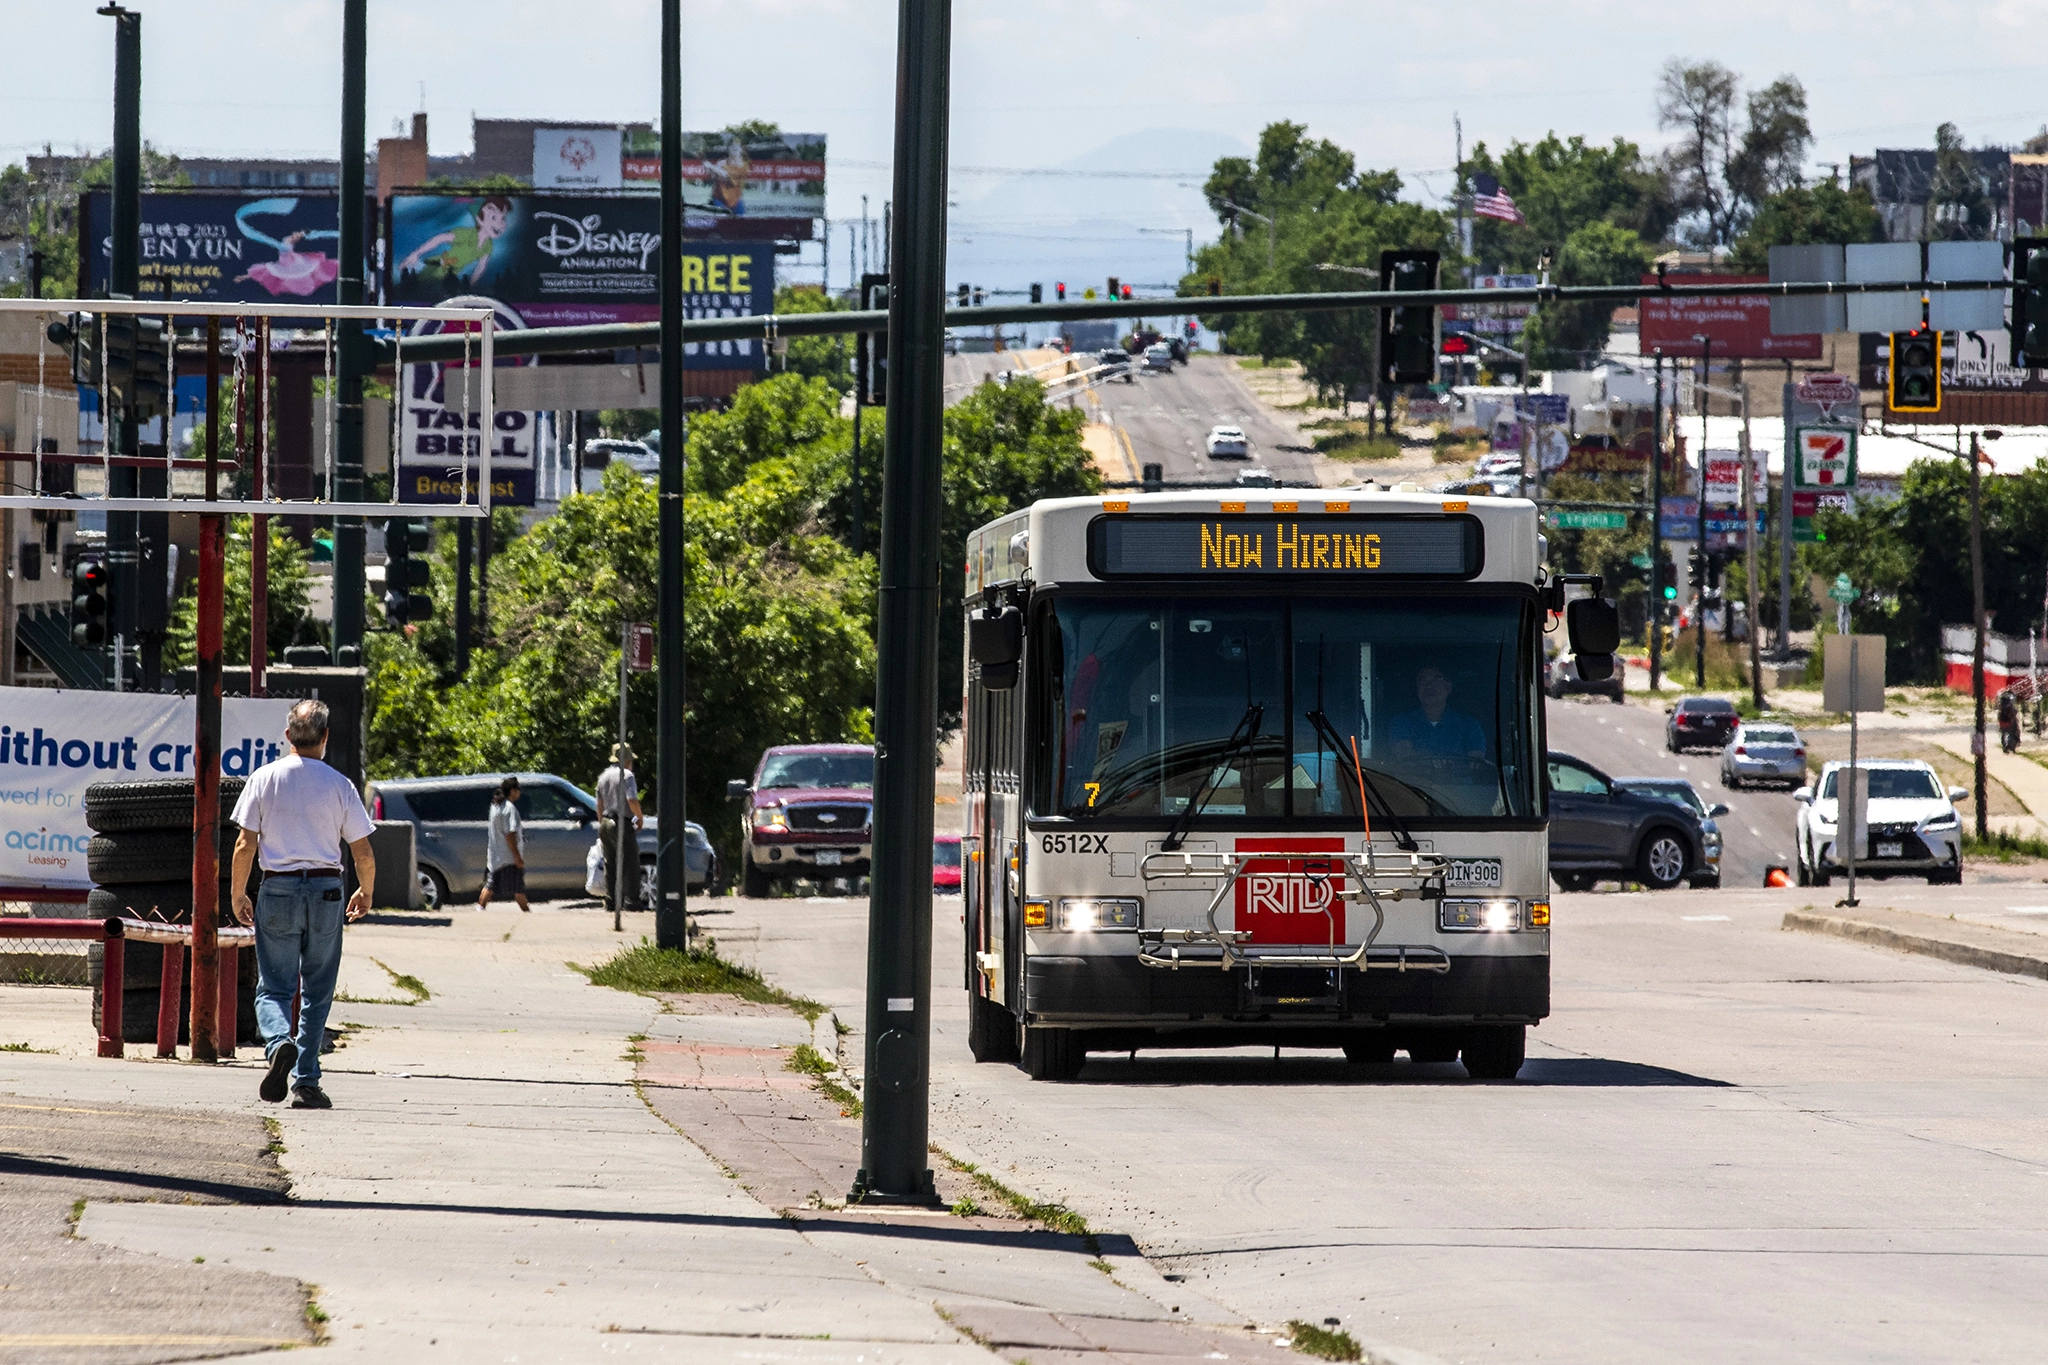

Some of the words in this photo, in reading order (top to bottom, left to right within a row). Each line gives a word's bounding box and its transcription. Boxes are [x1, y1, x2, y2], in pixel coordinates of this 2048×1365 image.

[102, 236, 178, 259] SEN
[185, 238, 243, 260] YUN
[559, 257, 643, 270] ANIMATION
[682, 294, 722, 308] LESS
[1960, 359, 1987, 373] ONLY
[0, 725, 138, 771] ithout
[149, 737, 280, 777] crdit
[0, 786, 39, 806] ved
[46, 788, 74, 808] for
[1084, 782, 1100, 807] 7
[1042, 834, 1109, 855] 6512X
[1247, 877, 1334, 914] RTD
